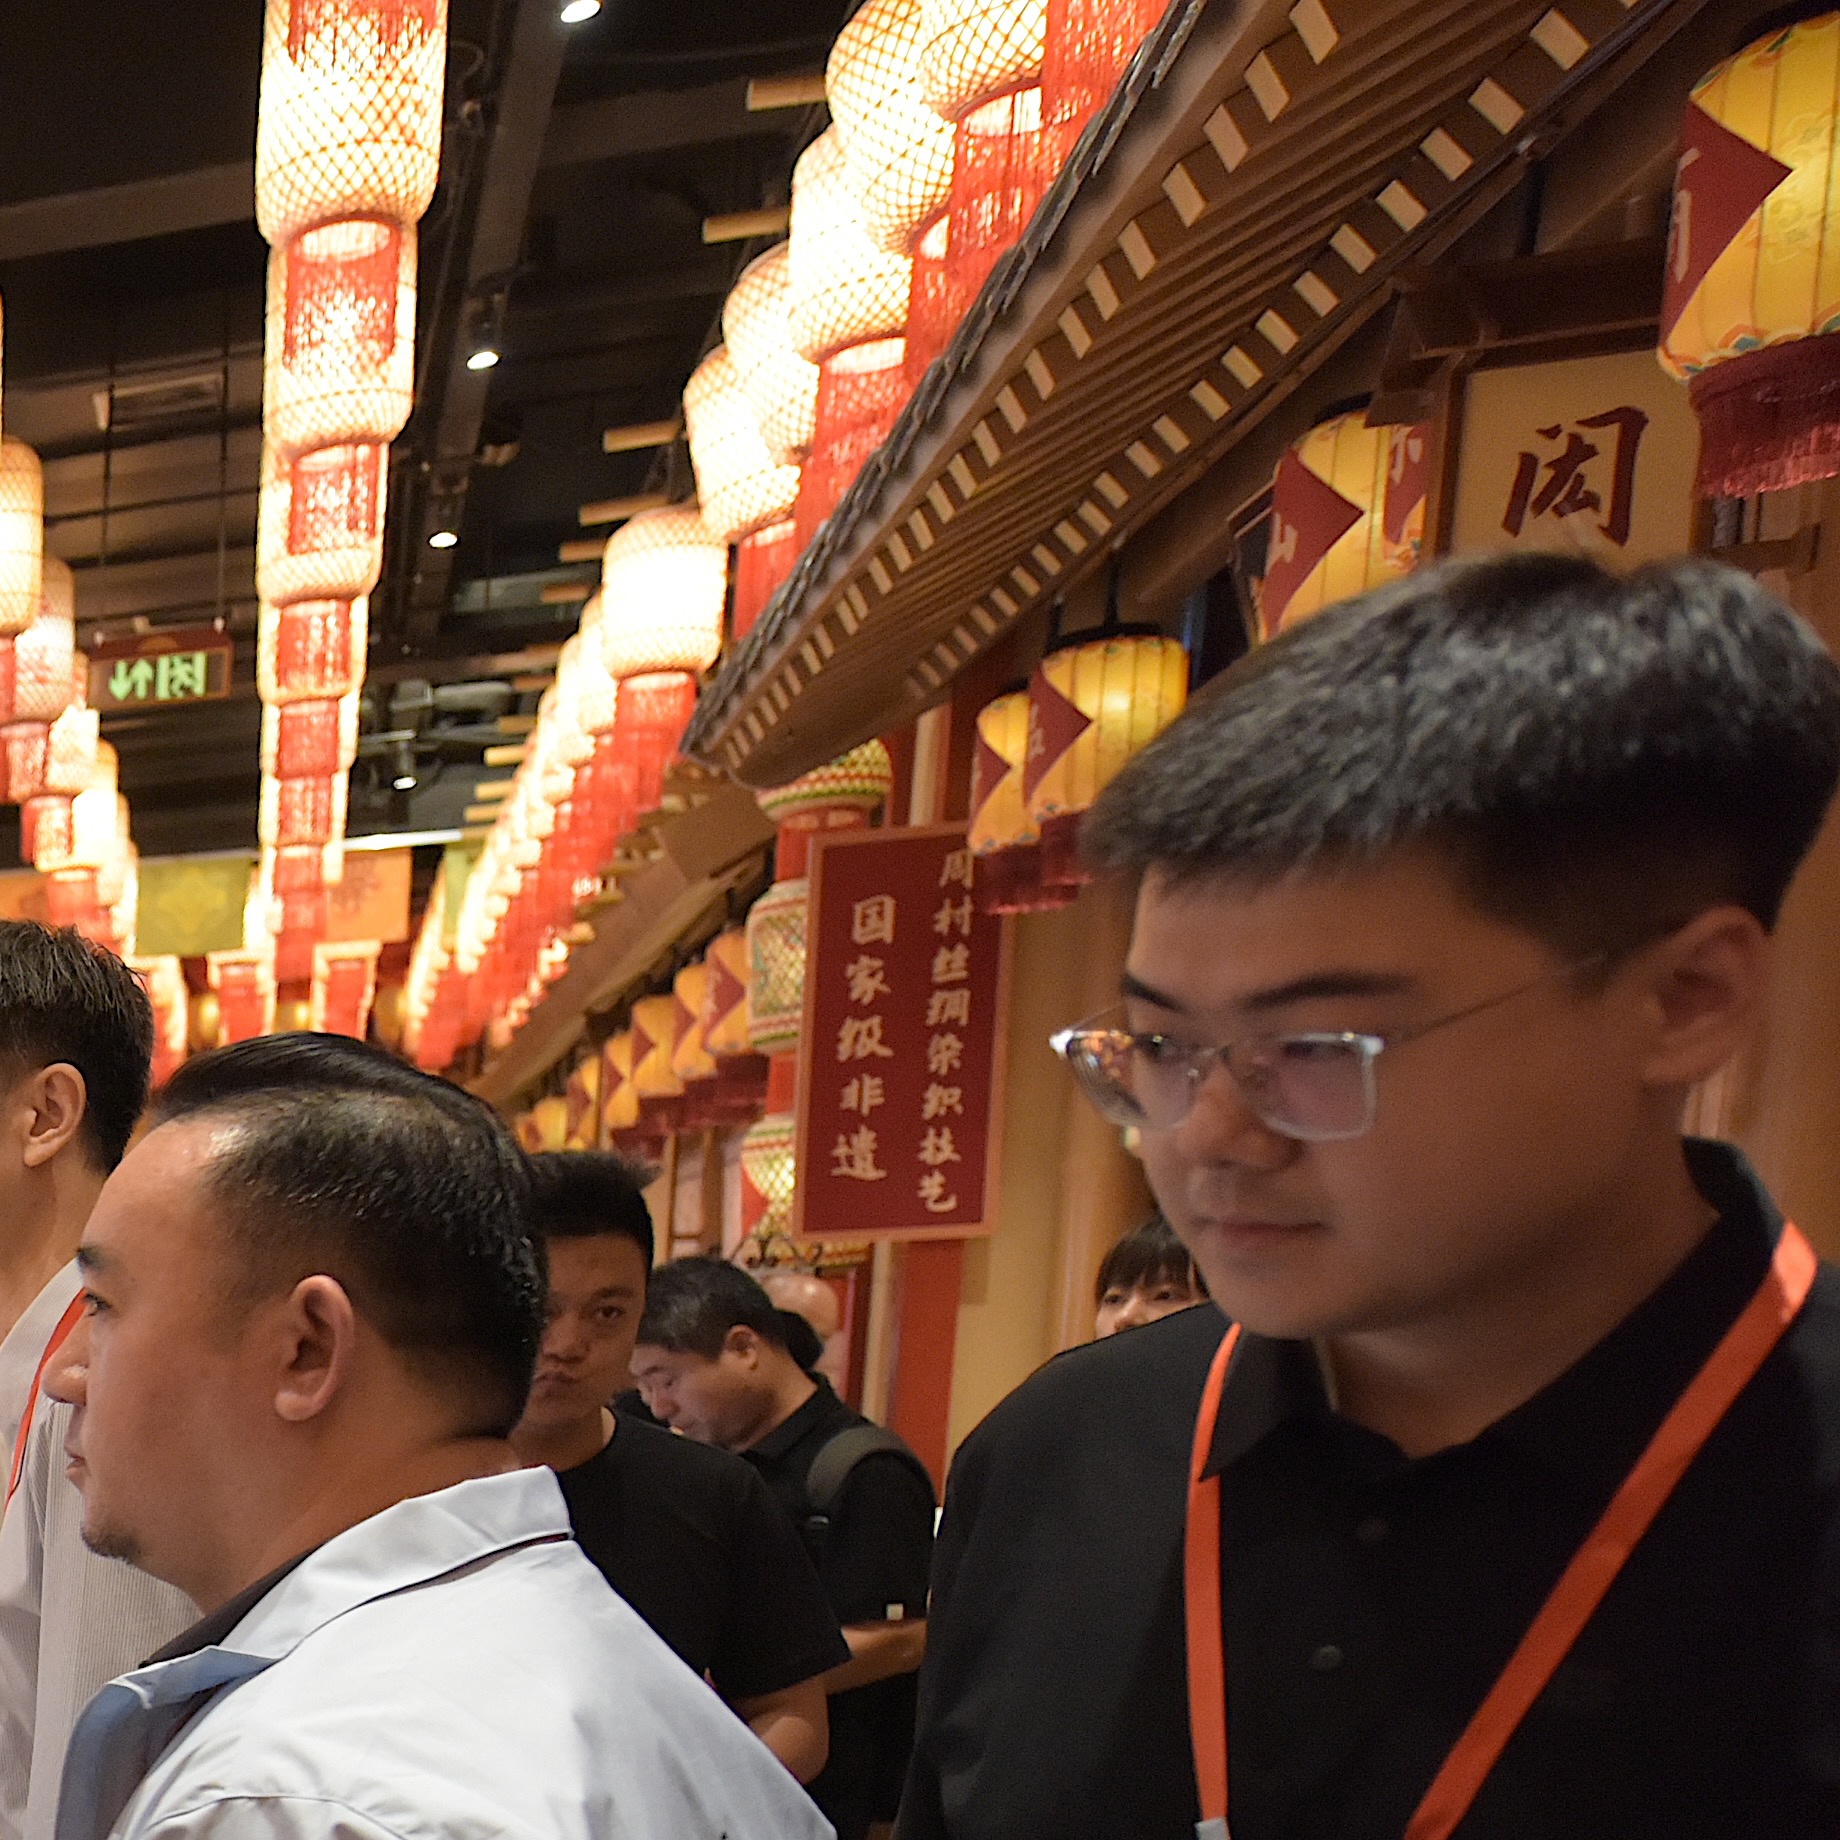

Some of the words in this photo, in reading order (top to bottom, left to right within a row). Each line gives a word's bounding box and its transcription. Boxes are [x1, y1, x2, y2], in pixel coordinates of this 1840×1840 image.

[830, 893, 896, 1182] 国家级非遗
